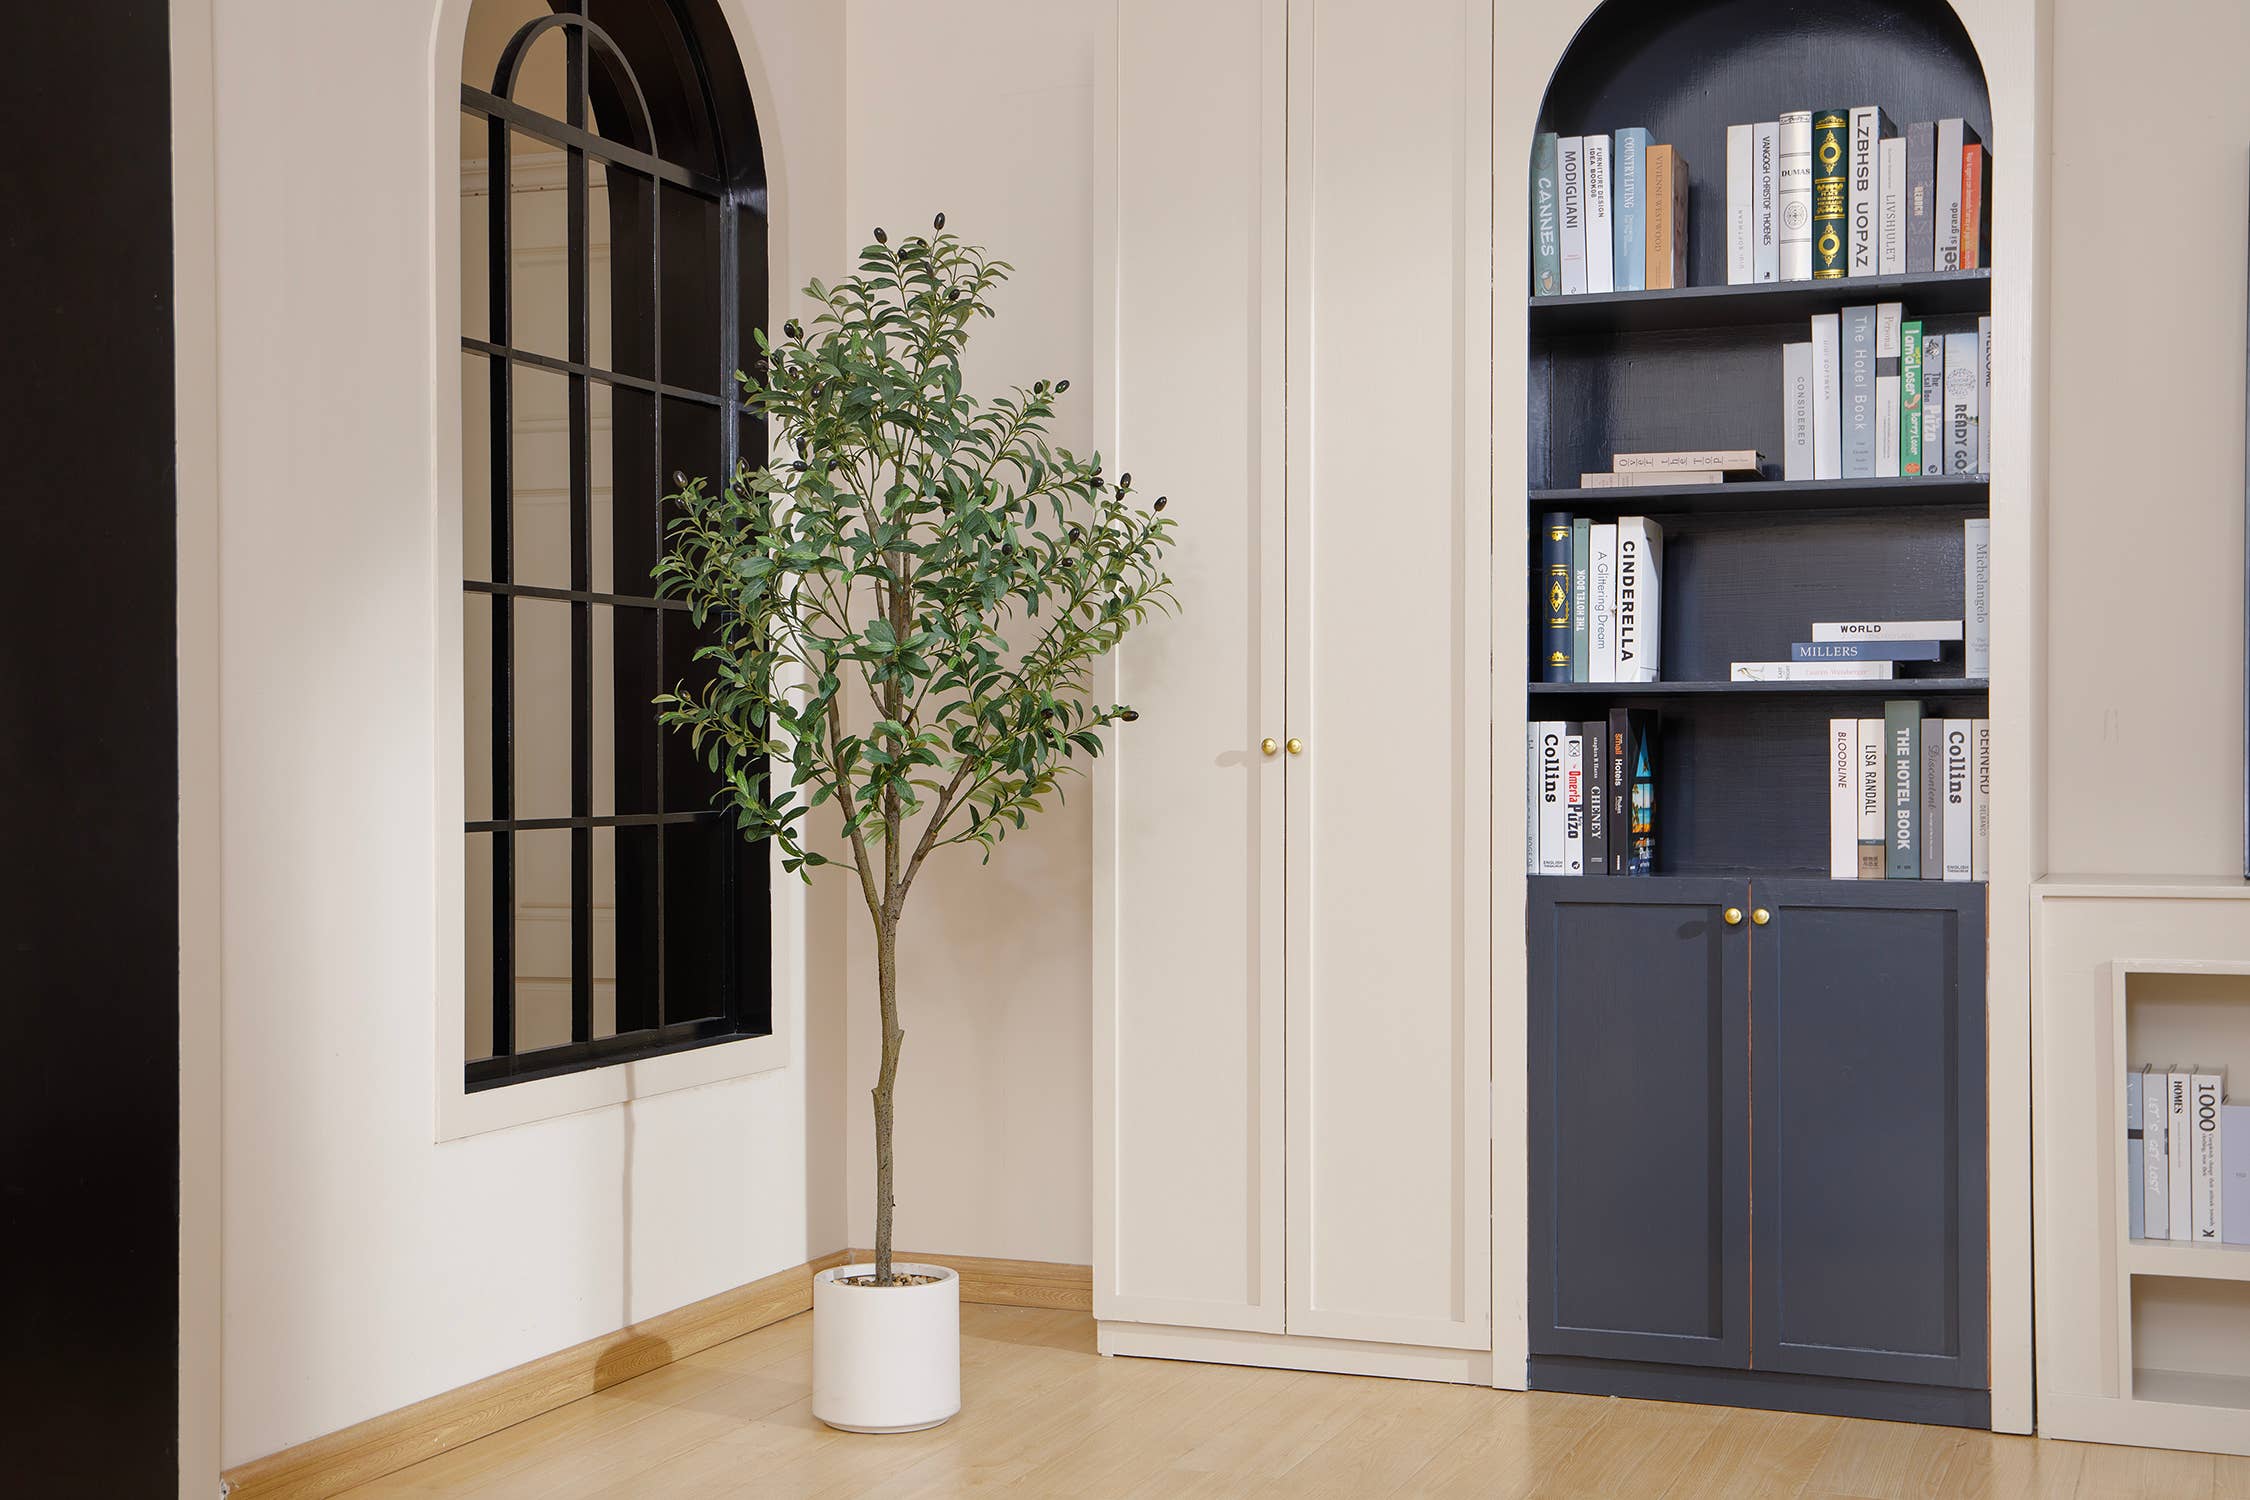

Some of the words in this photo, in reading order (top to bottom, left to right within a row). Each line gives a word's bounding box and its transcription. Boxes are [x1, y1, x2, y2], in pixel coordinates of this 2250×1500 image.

[1856, 113, 1871, 192] LZBHSB
[1565, 151, 1577, 229] MODIGLIANI
[1781, 168, 1811, 177] DUMAS
[1763, 176, 1771, 212] CHRISTOF
[1538, 178, 1554, 256] CANNES
[1856, 202, 1869, 267] UOPAZ
[1950, 202, 1959, 234] grande
[1854, 316, 1868, 343] The
[1855, 350, 1868, 388] Hotel
[1905, 364, 1919, 395] Loser
[1932, 371, 1941, 387] The
[1797, 376, 1805, 446] CONSIDERED
[1855, 395, 1867, 432] Book
[1955, 404, 1967, 446] READY
[1597, 551, 1607, 561] A
[1577, 569, 1585, 590] BOOK
[1595, 563, 1608, 612] Glittering
[1975, 543, 1988, 624] Michelangelo
[1576, 591, 1584, 616] HOTEL
[1621, 541, 1635, 662] CINDERELLA
[1576, 617, 1584, 631] THE
[1598, 613, 1608, 649] Dream
[1840, 625, 1881, 633] WORLD
[1800, 647, 1858, 657] MILLERS
[1838, 732, 1847, 788] BLOODLINE
[1865, 745, 1877, 767] LISA
[1896, 728, 1910, 756] THE
[1544, 734, 1560, 803] Collins
[1614, 759, 1623, 786] Hotels
[1896, 760, 1910, 806] HOTEL
[1949, 731, 1966, 804] Collins
[1569, 771, 1581, 803] Omerta
[1865, 772, 1877, 816] RANDALL
[1568, 804, 1582, 839] Puzo
[1591, 786, 1601, 839] CHENEY
[1897, 810, 1910, 850] BOOK
[2173, 1081, 2183, 1114] HOMES
[2198, 1083, 2216, 1132] 1000
